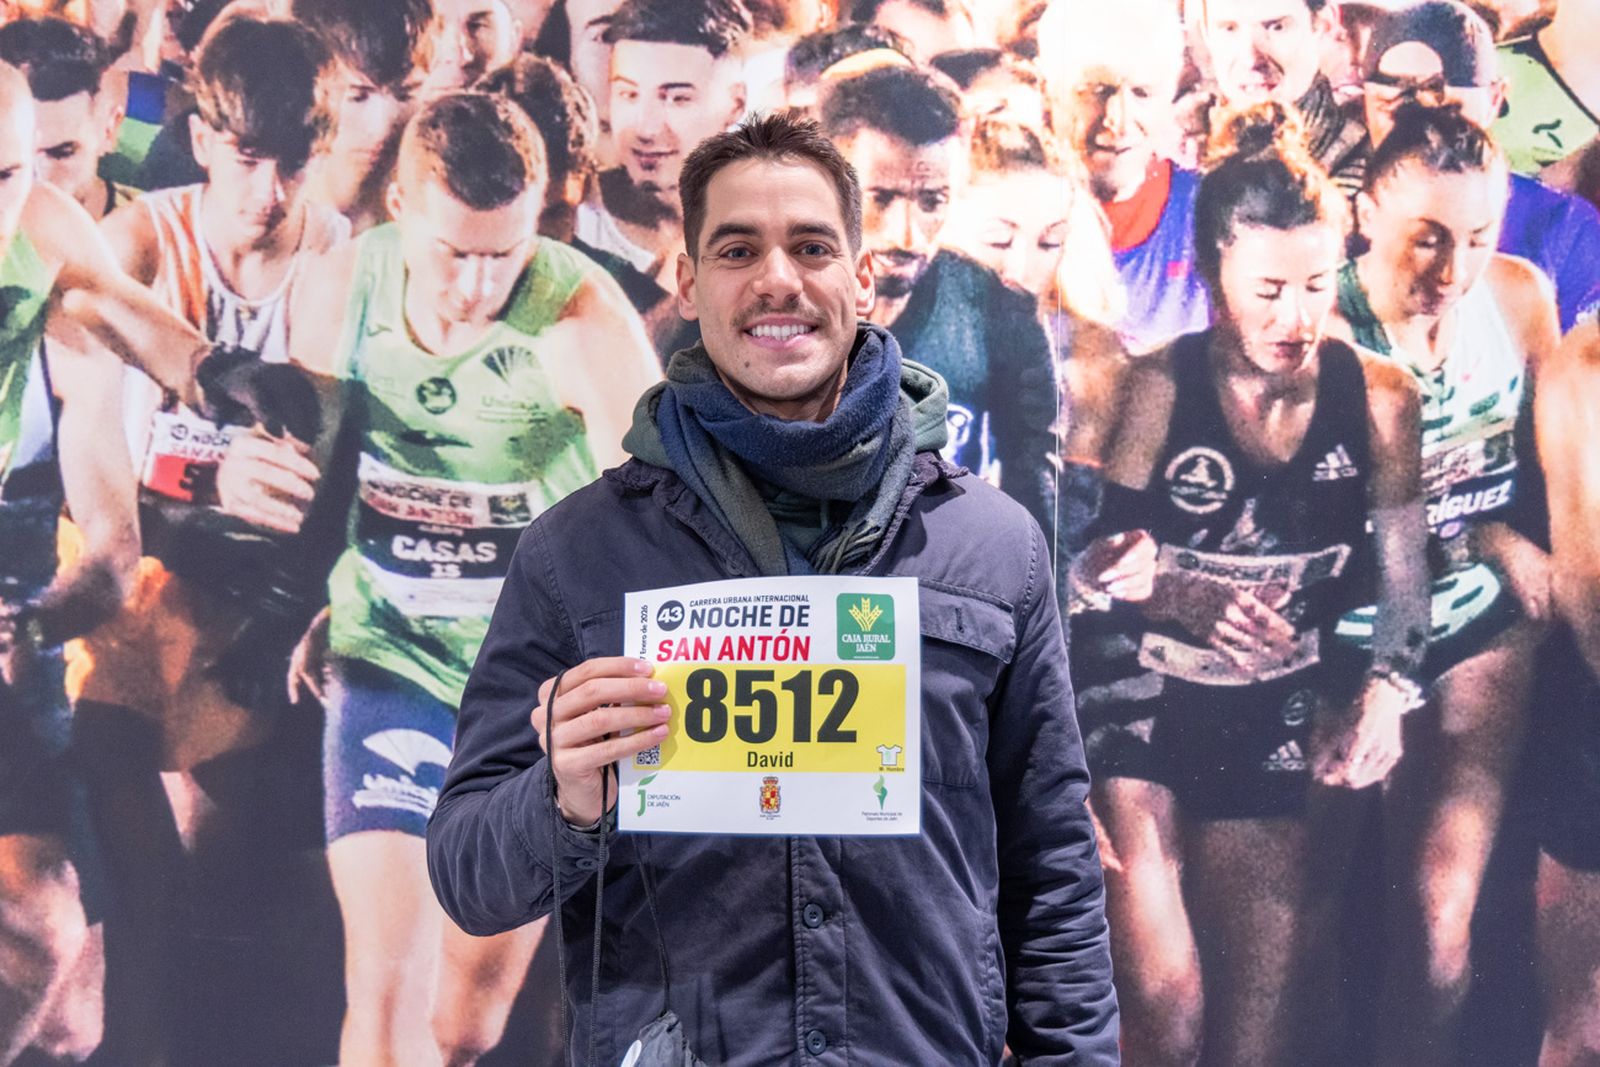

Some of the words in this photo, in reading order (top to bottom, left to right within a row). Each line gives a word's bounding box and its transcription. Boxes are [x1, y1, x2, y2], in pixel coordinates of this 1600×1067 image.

[191, 433, 231, 446] NOCH
[391, 534, 498, 563] CASAS
[689, 599, 722, 608] CARRERA
[723, 596, 752, 605] URBANA
[753, 594, 810, 603] INTERNACIONAL
[640, 604, 649, 624] 2026
[657, 606, 683, 624] 43
[689, 605, 773, 629] NOCHE
[779, 604, 811, 628] DE
[639, 624, 648, 634] de
[656, 639, 712, 662] SAN
[717, 628, 811, 662] ANTÓN
[841, 633, 862, 644] CAJA
[863, 633, 892, 644] RURAL
[685, 668, 860, 744] 8512
[747, 751, 794, 768] David
